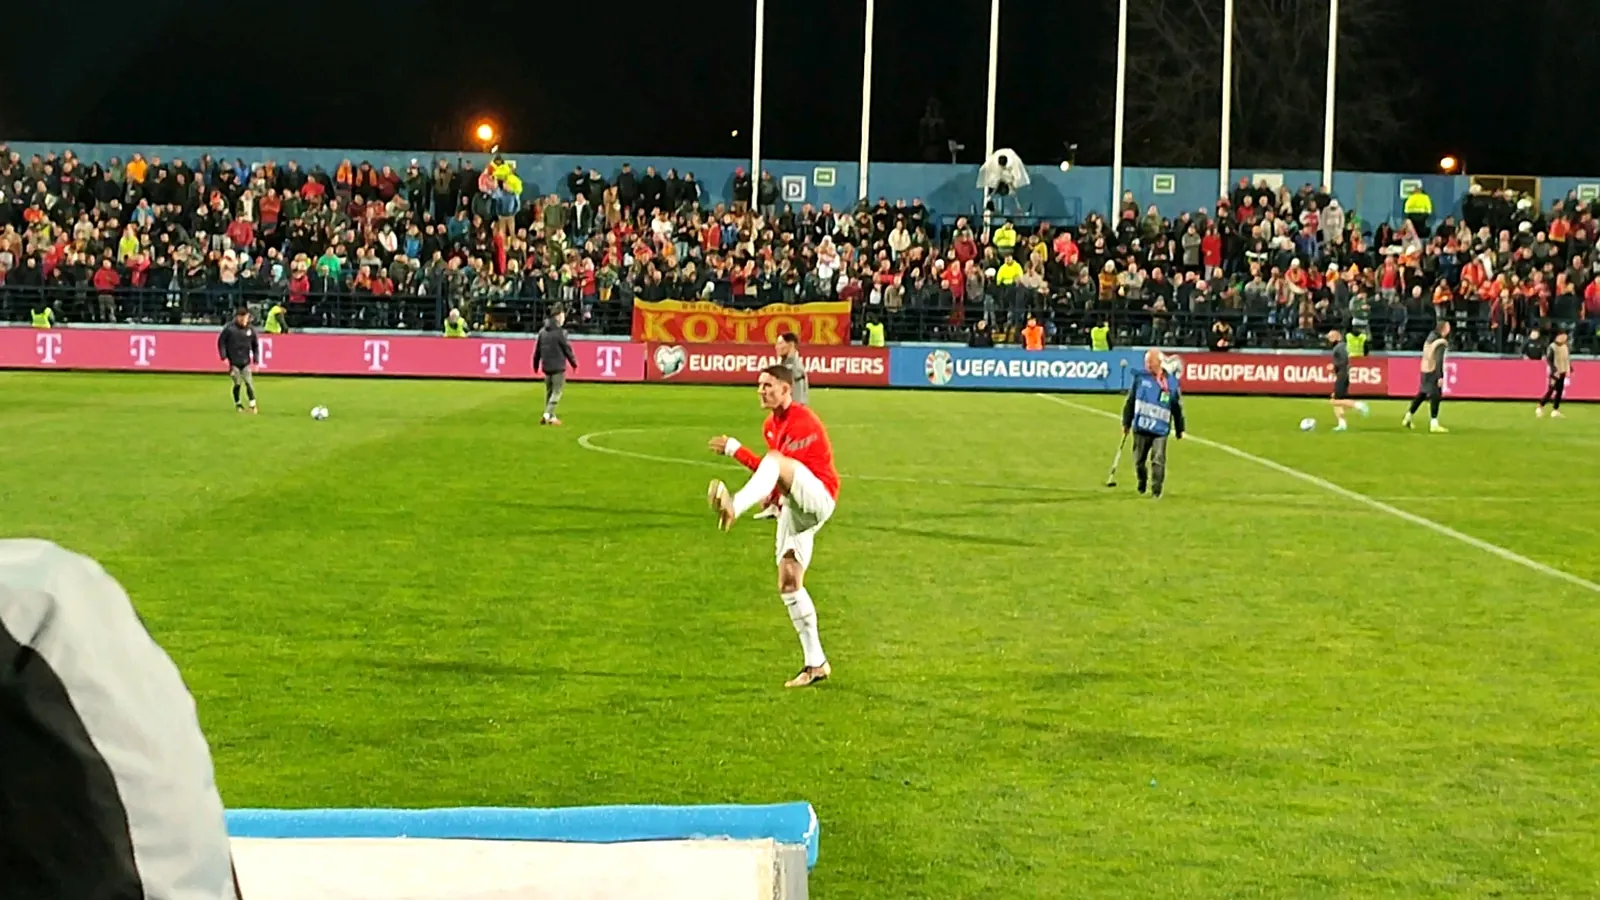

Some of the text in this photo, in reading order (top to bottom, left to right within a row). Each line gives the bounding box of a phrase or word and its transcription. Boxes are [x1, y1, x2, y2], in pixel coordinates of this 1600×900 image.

[788, 182, 801, 197] D
[640, 309, 844, 345] KOTOR
[36, 333, 62, 364] T
[130, 335, 156, 366] T
[364, 340, 389, 371] T
[480, 343, 506, 374] T
[596, 346, 622, 377] T
[799, 356, 884, 375] UALIFIERS
[1186, 363, 1382, 384] EUROPEAN QUALERS
